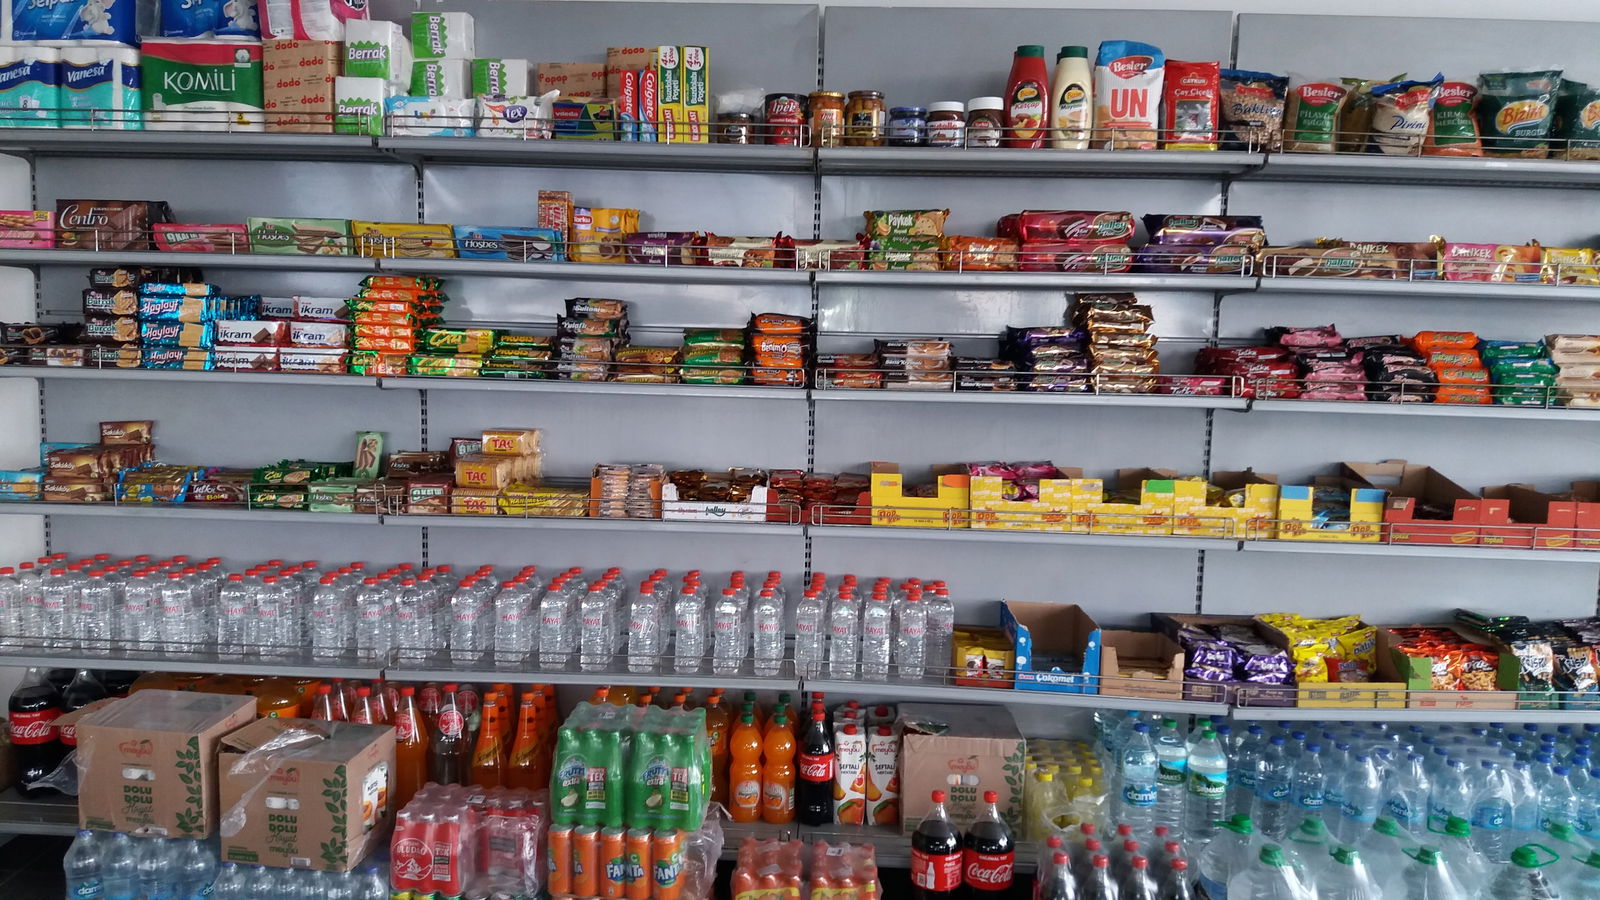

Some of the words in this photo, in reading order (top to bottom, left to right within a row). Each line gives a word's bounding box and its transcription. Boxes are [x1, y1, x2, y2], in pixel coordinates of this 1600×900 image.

[429, 15, 444, 55] Berrak
[275, 40, 298, 50] dodo
[348, 47, 386, 60] Berrak
[300, 56, 323, 67] dodo
[1113, 61, 1147, 72] Besler
[0, 66, 31, 83] anesa
[67, 66, 105, 83] Vanesa
[426, 63, 438, 96] Berra
[489, 61, 500, 95] Berra
[164, 69, 236, 94] KOMİLİ
[277, 77, 300, 88] dodo
[625, 72, 633, 114] Colgate
[645, 73, 654, 117] Colgate
[1303, 87, 1341, 98] Besler
[301, 94, 325, 104] dodo
[1110, 88, 1147, 118] UN
[60, 205, 108, 229] Centro
[888, 213, 913, 227] Paykek
[1098, 221, 1127, 234] halley
[1169, 219, 1198, 228] halley
[1325, 258, 1355, 271] halley
[300, 305, 333, 315] ikram
[141, 326, 180, 340] Haylayf
[220, 330, 252, 339] ikram
[292, 331, 325, 341] ikram
[465, 471, 487, 483] TAÇ
[865, 627, 884, 635] HAYAT
[839, 762, 860, 771] ŞEFTALİ
[562, 776, 580, 787] extra
[590, 772, 604, 781] TEK
[646, 777, 664, 786] extra
[124, 785, 152, 794] DOLU
[950, 786, 977, 794] DOLU
[124, 794, 153, 804] DOLU
[269, 814, 298, 824] DOLU
[269, 824, 298, 834] DOLU
[607, 861, 626, 878] FAN
[626, 863, 644, 878] NTA
[968, 863, 1013, 884] Coca-Cola
